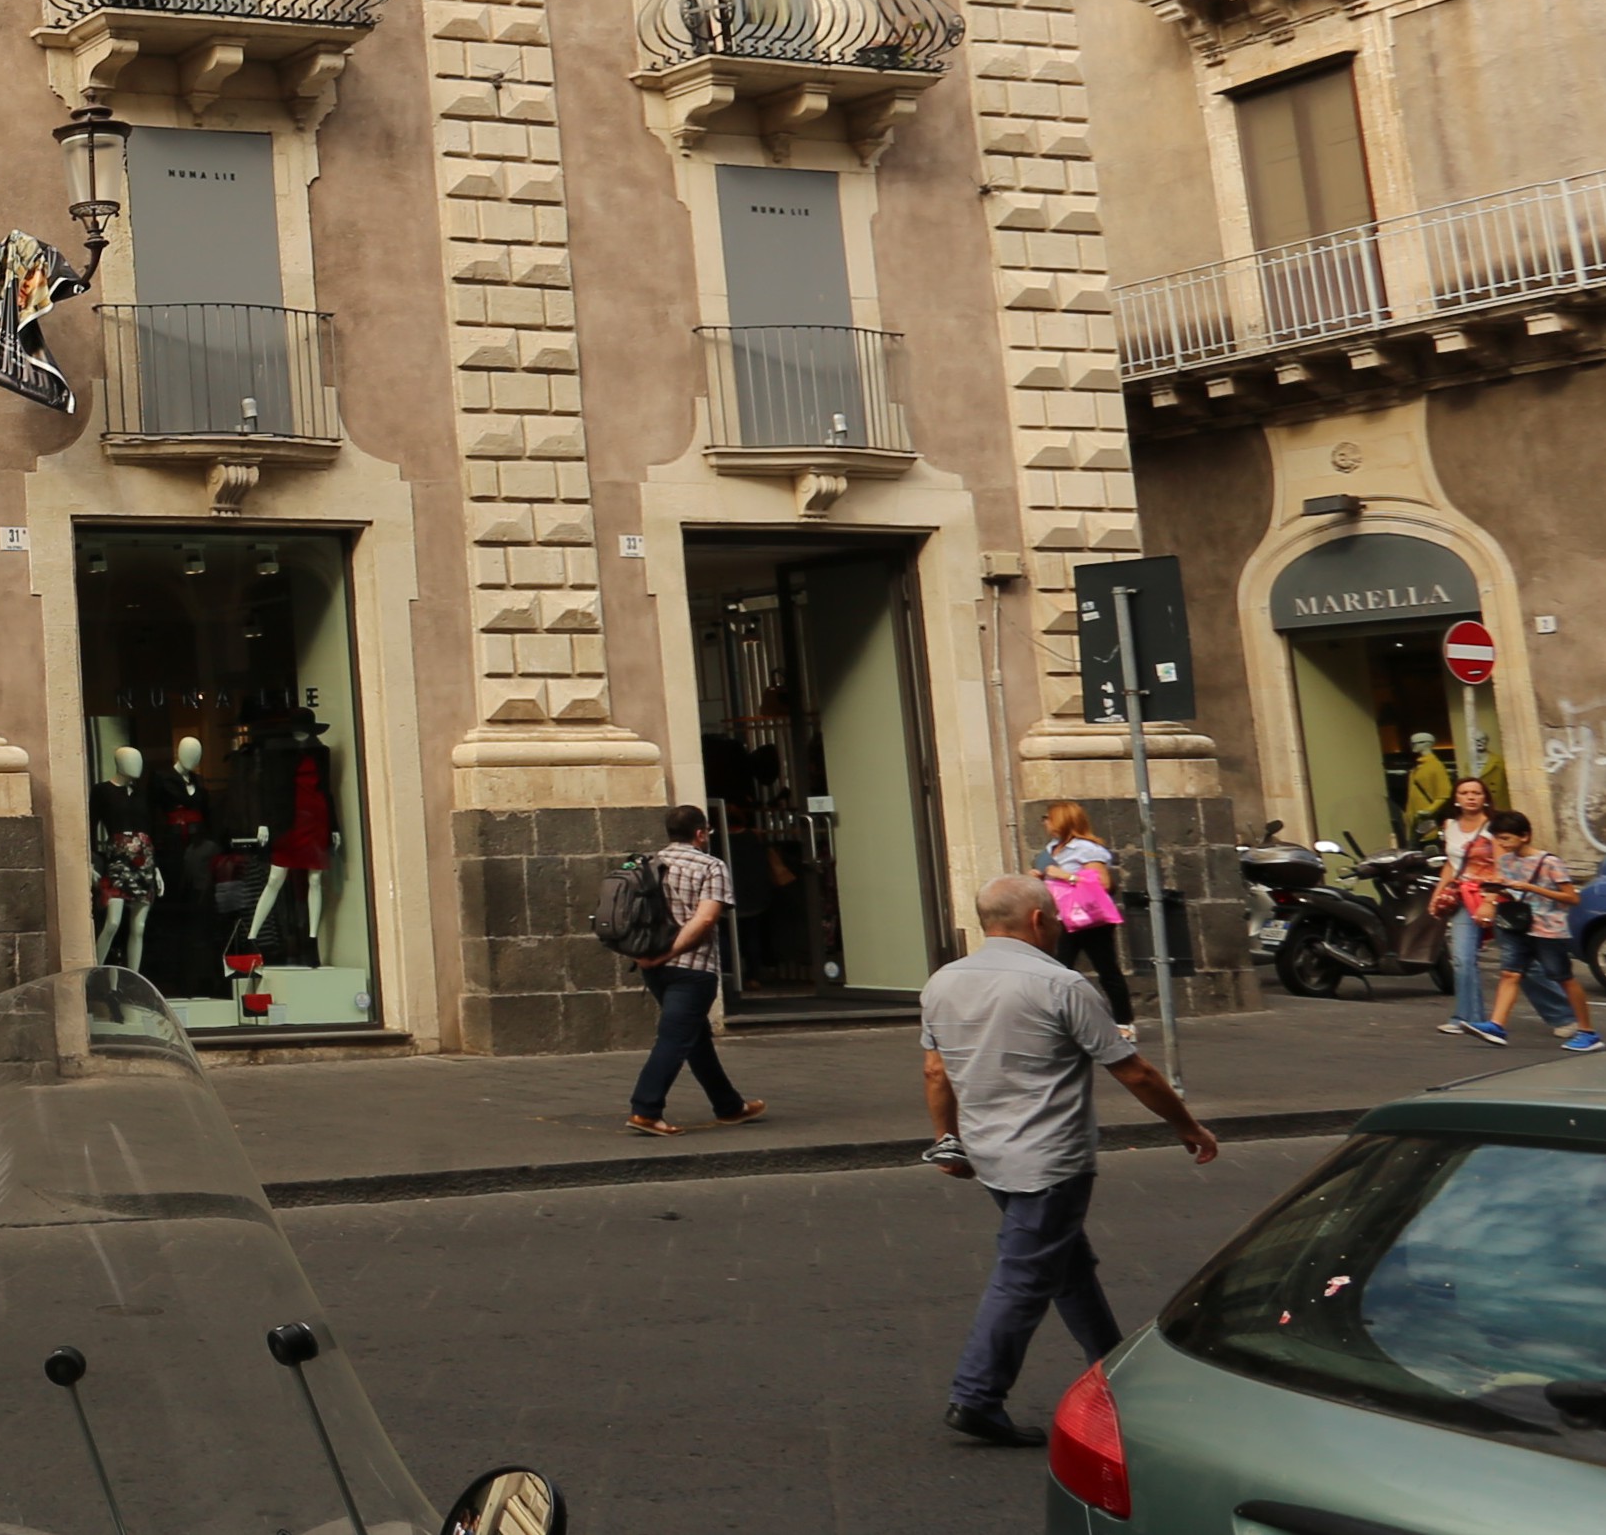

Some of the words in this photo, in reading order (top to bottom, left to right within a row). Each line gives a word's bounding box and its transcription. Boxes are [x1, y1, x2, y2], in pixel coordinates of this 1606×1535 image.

[168, 169, 207, 179] NUNA
[9, 529, 20, 542] 31
[1294, 584, 1453, 616] MARELLA
